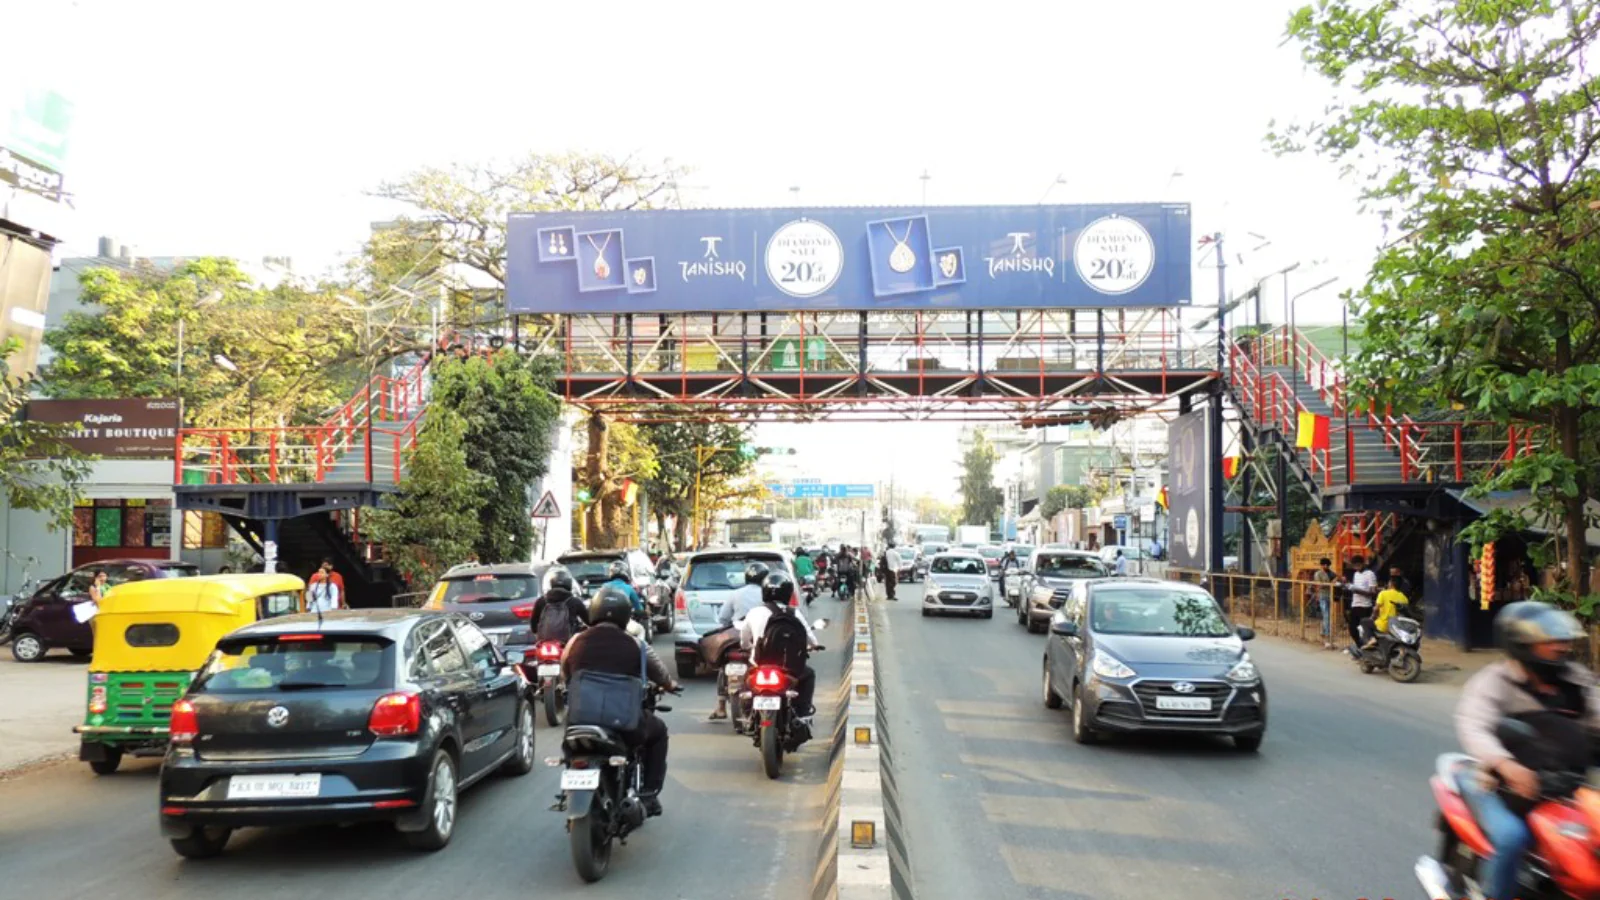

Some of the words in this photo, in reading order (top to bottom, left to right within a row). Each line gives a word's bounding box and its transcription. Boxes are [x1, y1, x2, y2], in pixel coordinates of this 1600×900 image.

[777, 238, 832, 247] DIAMOND
[1087, 235, 1142, 244] DIAMOND
[84, 413, 123, 424] Kajaria
[105, 427, 175, 440] BOUTIQUE
